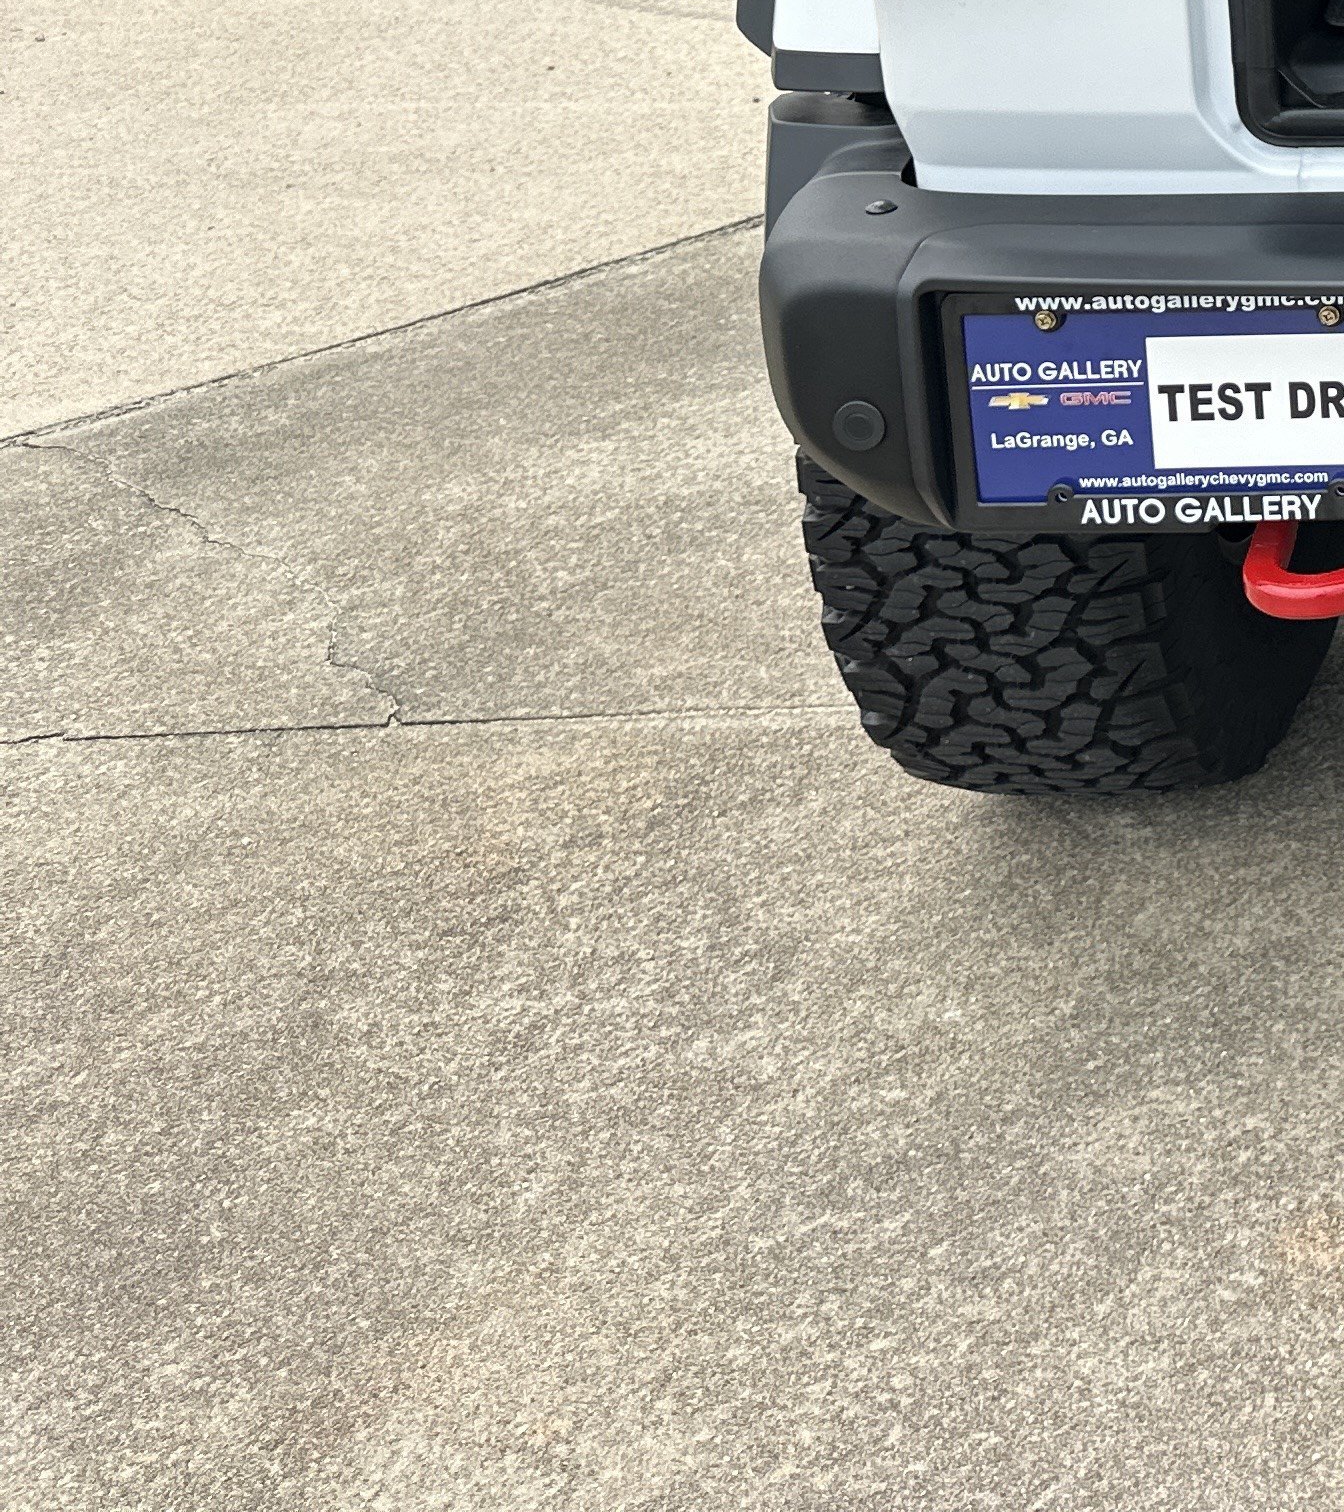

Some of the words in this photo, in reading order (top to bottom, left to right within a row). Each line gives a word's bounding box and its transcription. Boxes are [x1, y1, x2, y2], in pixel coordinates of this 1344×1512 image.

[971, 362, 1032, 383] AUTO
[1038, 359, 1143, 381] GALLERY
[1059, 391, 1131, 405] GMC
[1158, 382, 1271, 421] TEST
[991, 432, 1096, 451] LaGrange,
[1101, 430, 1134, 446] GA
[1079, 471, 1329, 489] www.autogallerychevygmc.com
[1081, 498, 1166, 524] AUTO
[1175, 494, 1322, 523] GALLERY
